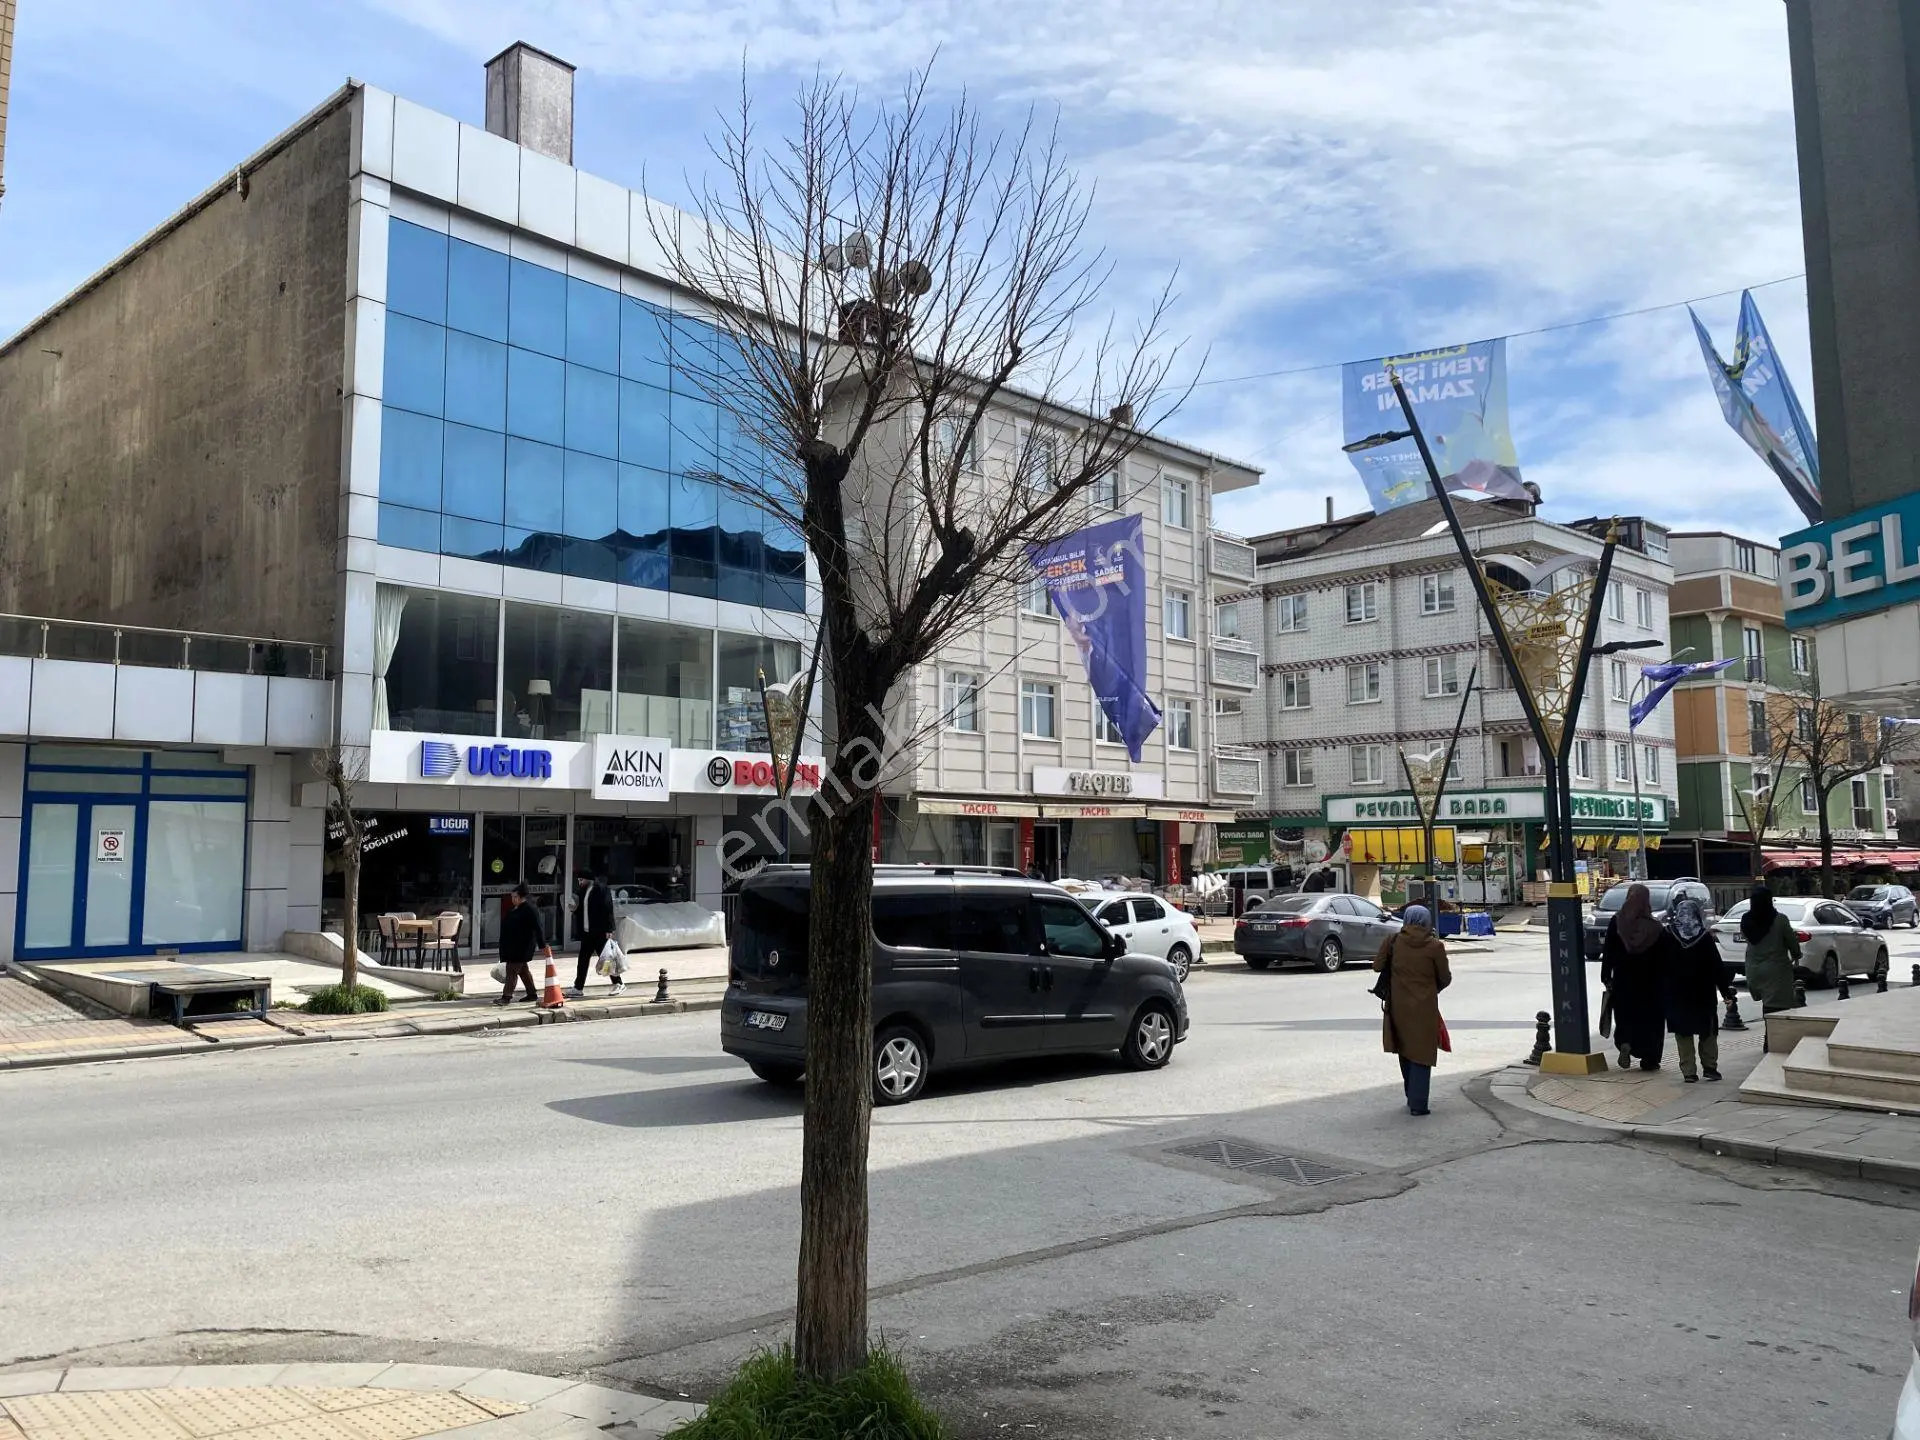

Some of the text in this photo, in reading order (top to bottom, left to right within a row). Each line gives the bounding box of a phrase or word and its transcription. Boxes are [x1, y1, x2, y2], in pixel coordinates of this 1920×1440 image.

[1094, 563, 1124, 578] SADECE
[468, 743, 552, 779] UĞUR
[606, 749, 663, 774] AKIN
[612, 773, 664, 788] MOBİLYA
[734, 760, 819, 789] BOH
[1069, 771, 1134, 795] TAÇPER
[1450, 798, 1506, 816] BABA
[362, 827, 409, 853] SOĞUTUN
